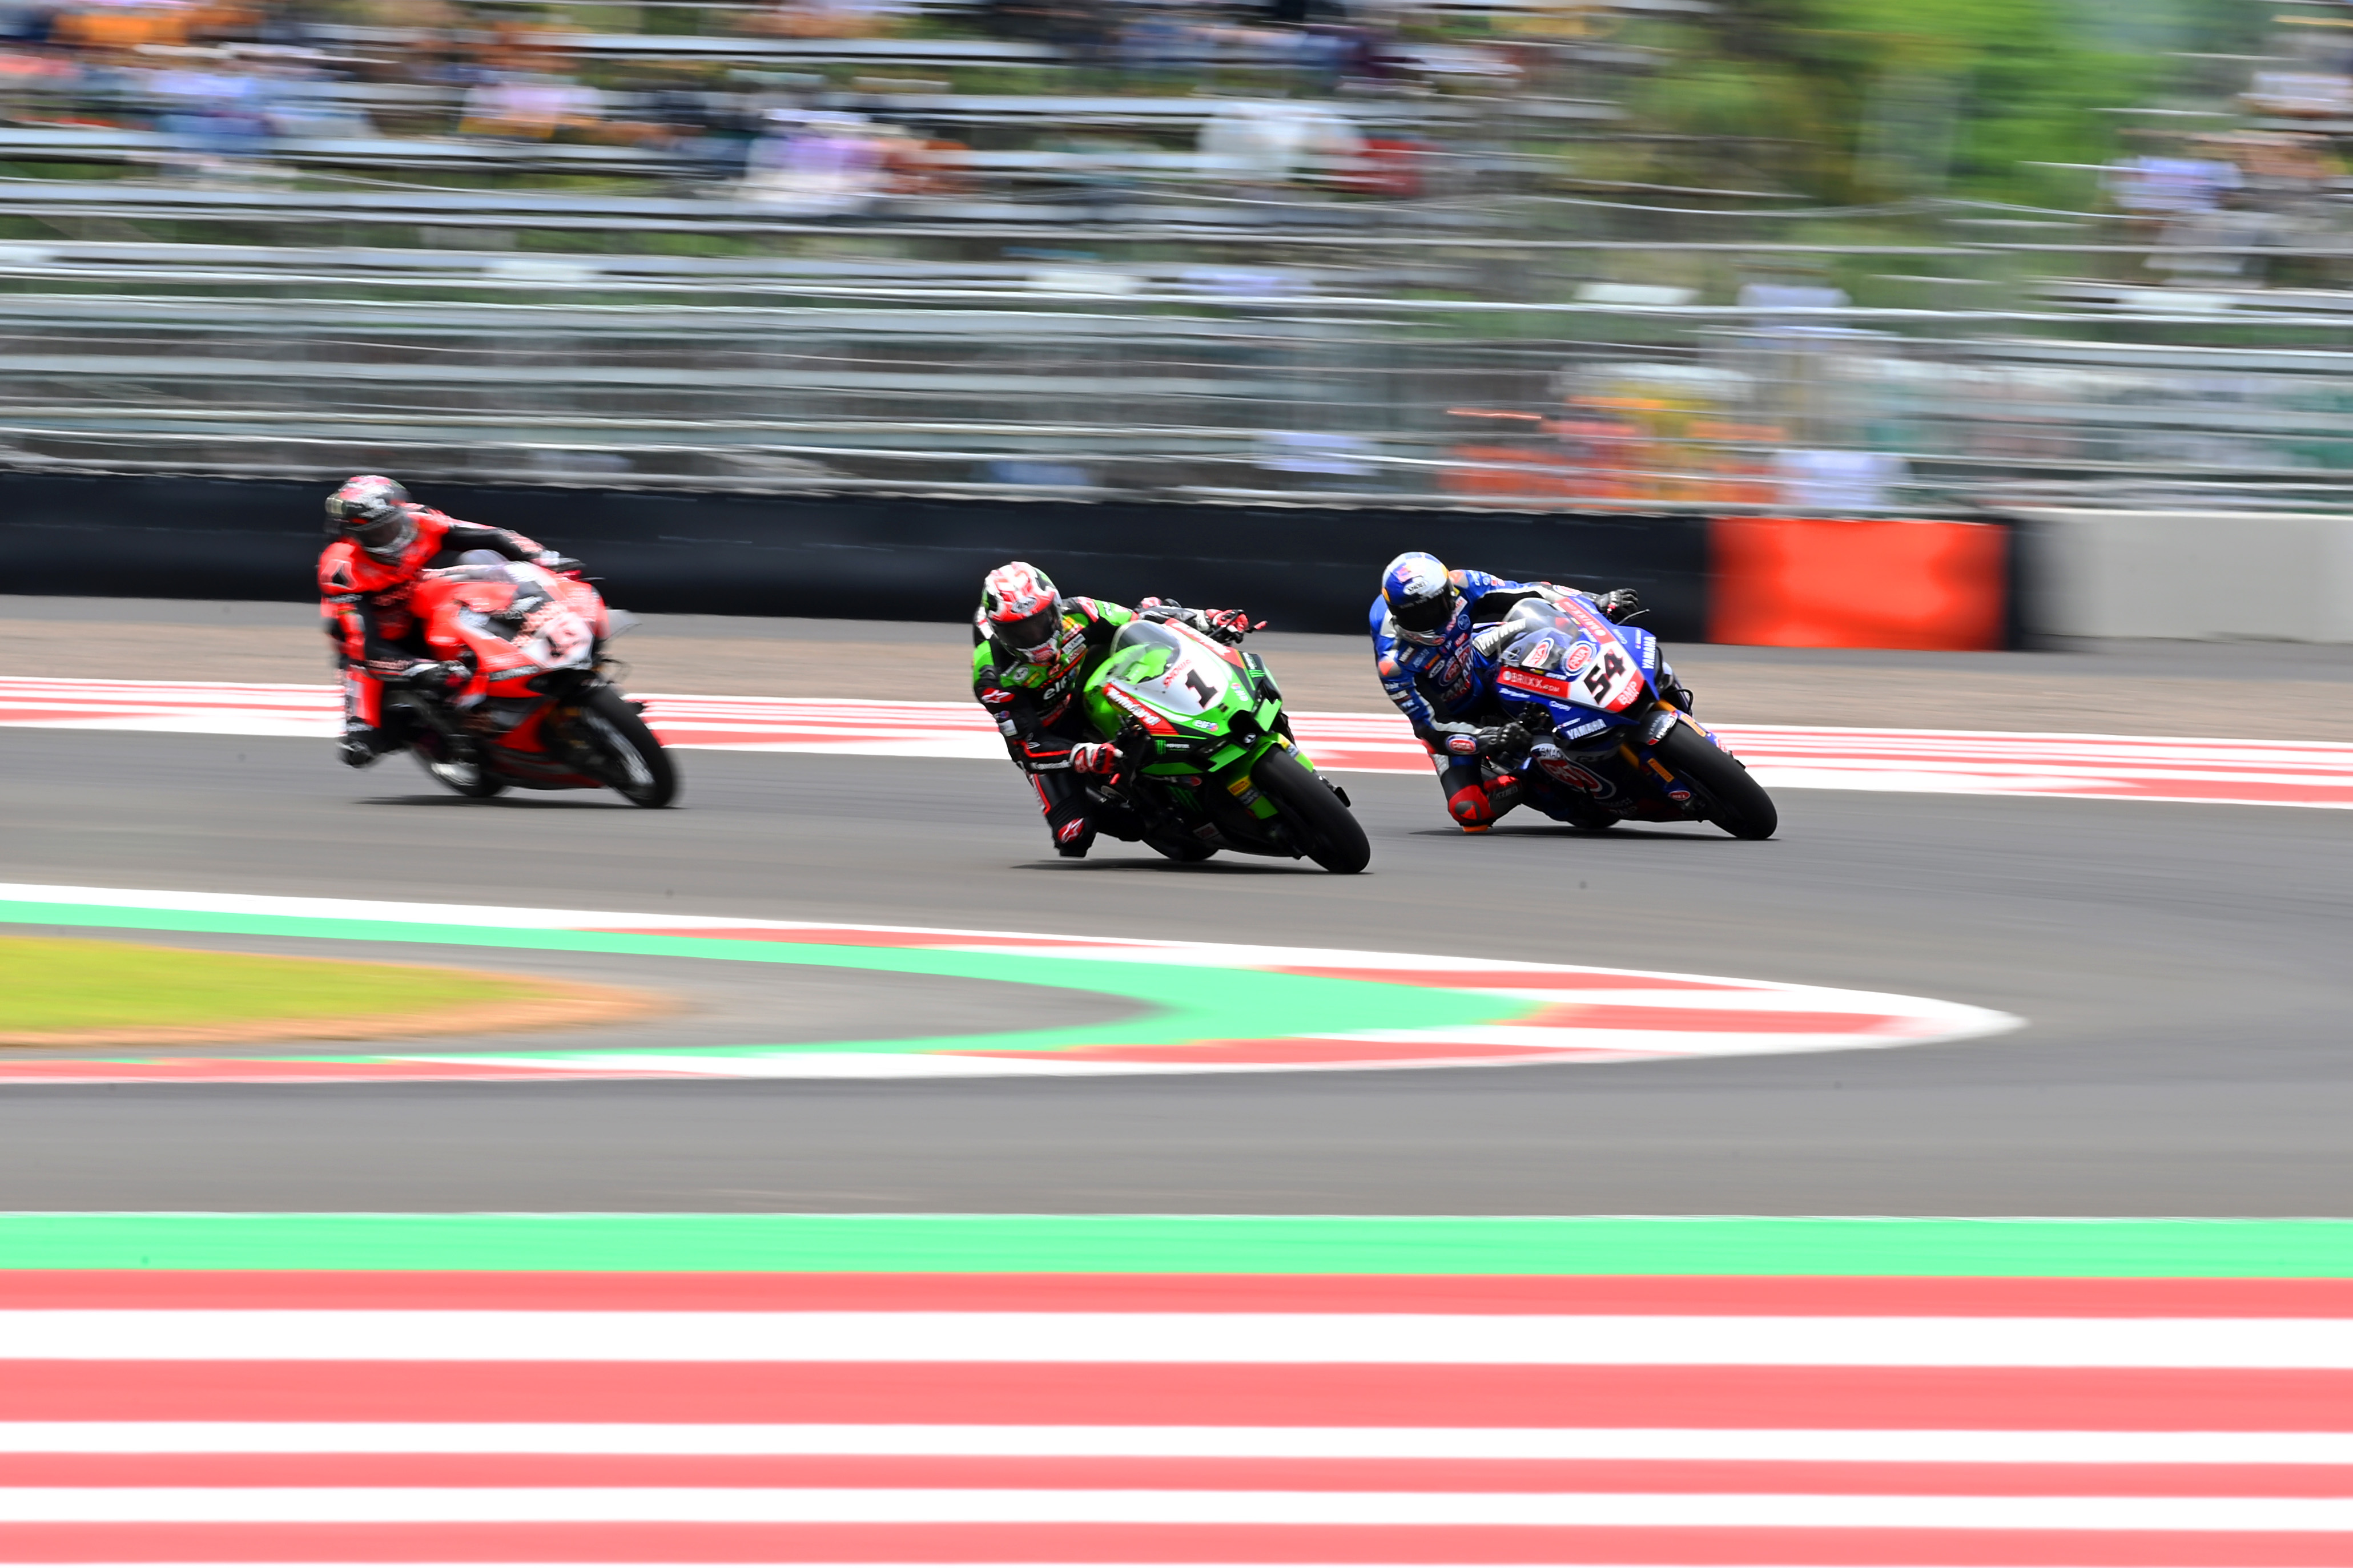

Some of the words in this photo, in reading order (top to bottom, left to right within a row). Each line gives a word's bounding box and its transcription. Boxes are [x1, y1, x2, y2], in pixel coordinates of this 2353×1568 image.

[1642, 636, 1656, 669] YAMAHA
[1043, 676, 1068, 700] elf
[1185, 668, 1218, 710] 1
[1583, 650, 1626, 704] 54
[1566, 719, 1607, 740] YAMAHA
